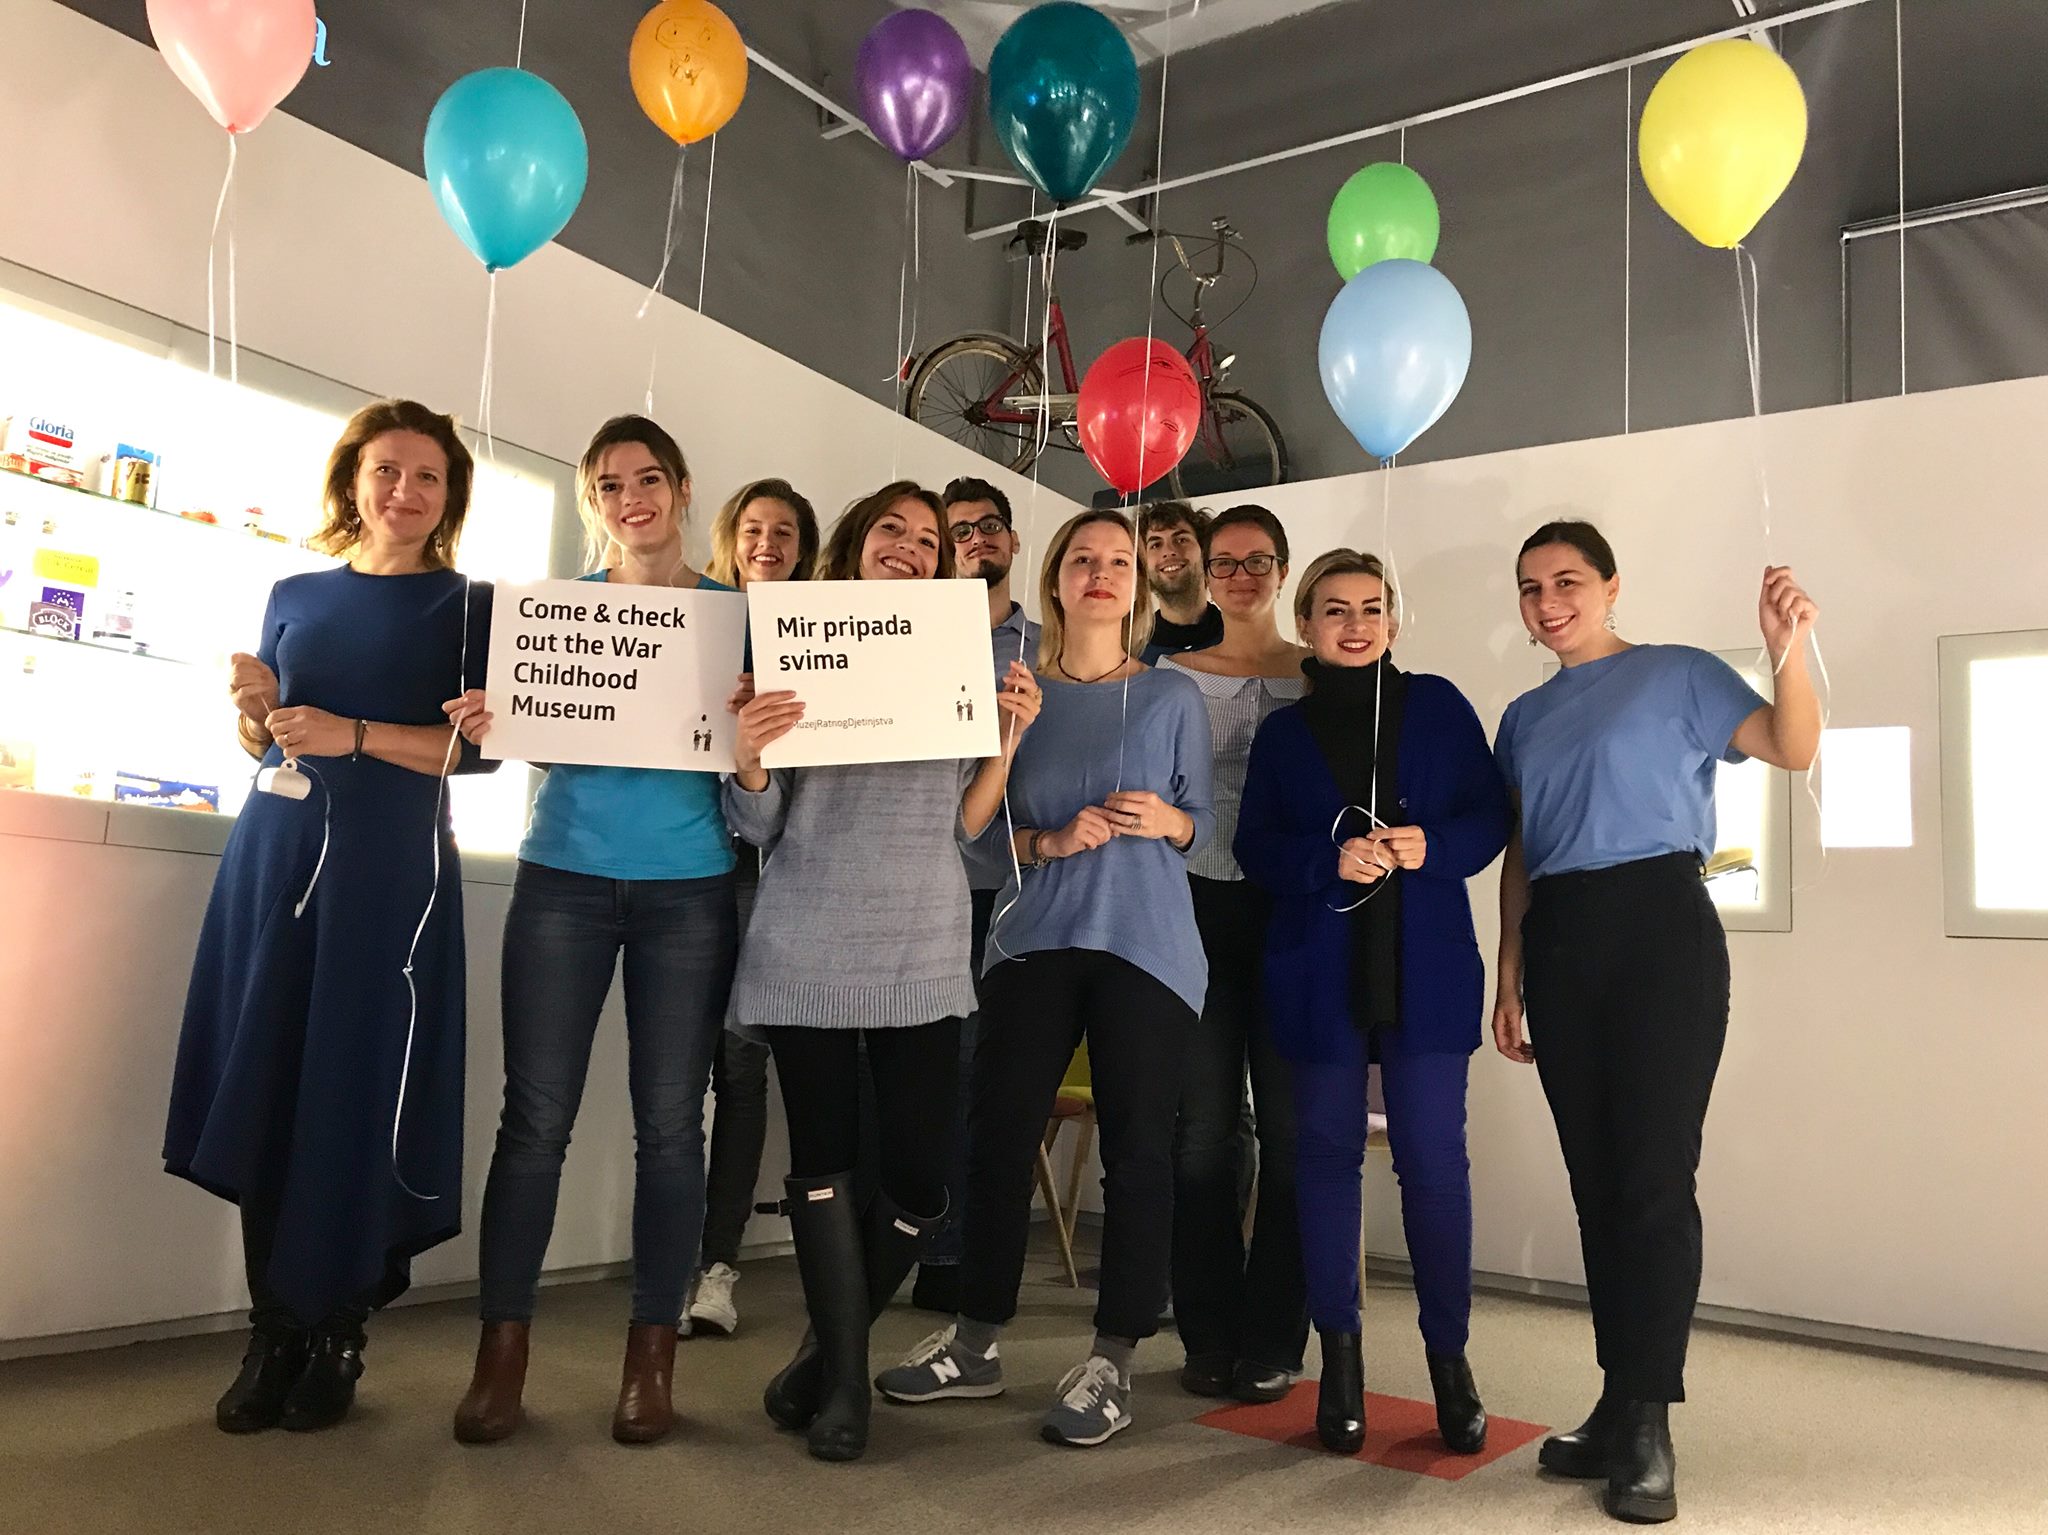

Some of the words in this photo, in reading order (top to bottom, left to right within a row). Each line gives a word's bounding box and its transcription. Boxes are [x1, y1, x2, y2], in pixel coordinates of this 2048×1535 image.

[30, 416, 74, 440] Gloria
[38, 614, 70, 630] BLOCK
[519, 597, 587, 622] Come
[593, 603, 611, 624] &
[617, 604, 686, 629] check
[777, 616, 817, 638] Mir
[823, 614, 912, 643] pripada
[516, 633, 558, 653] out
[563, 632, 604, 655] the
[611, 635, 662, 659] War
[779, 649, 849, 672] svima
[514, 661, 638, 690] Childhood
[511, 694, 616, 722] Museum
[930, 1356, 961, 1384] N
[1102, 1399, 1121, 1426] N
